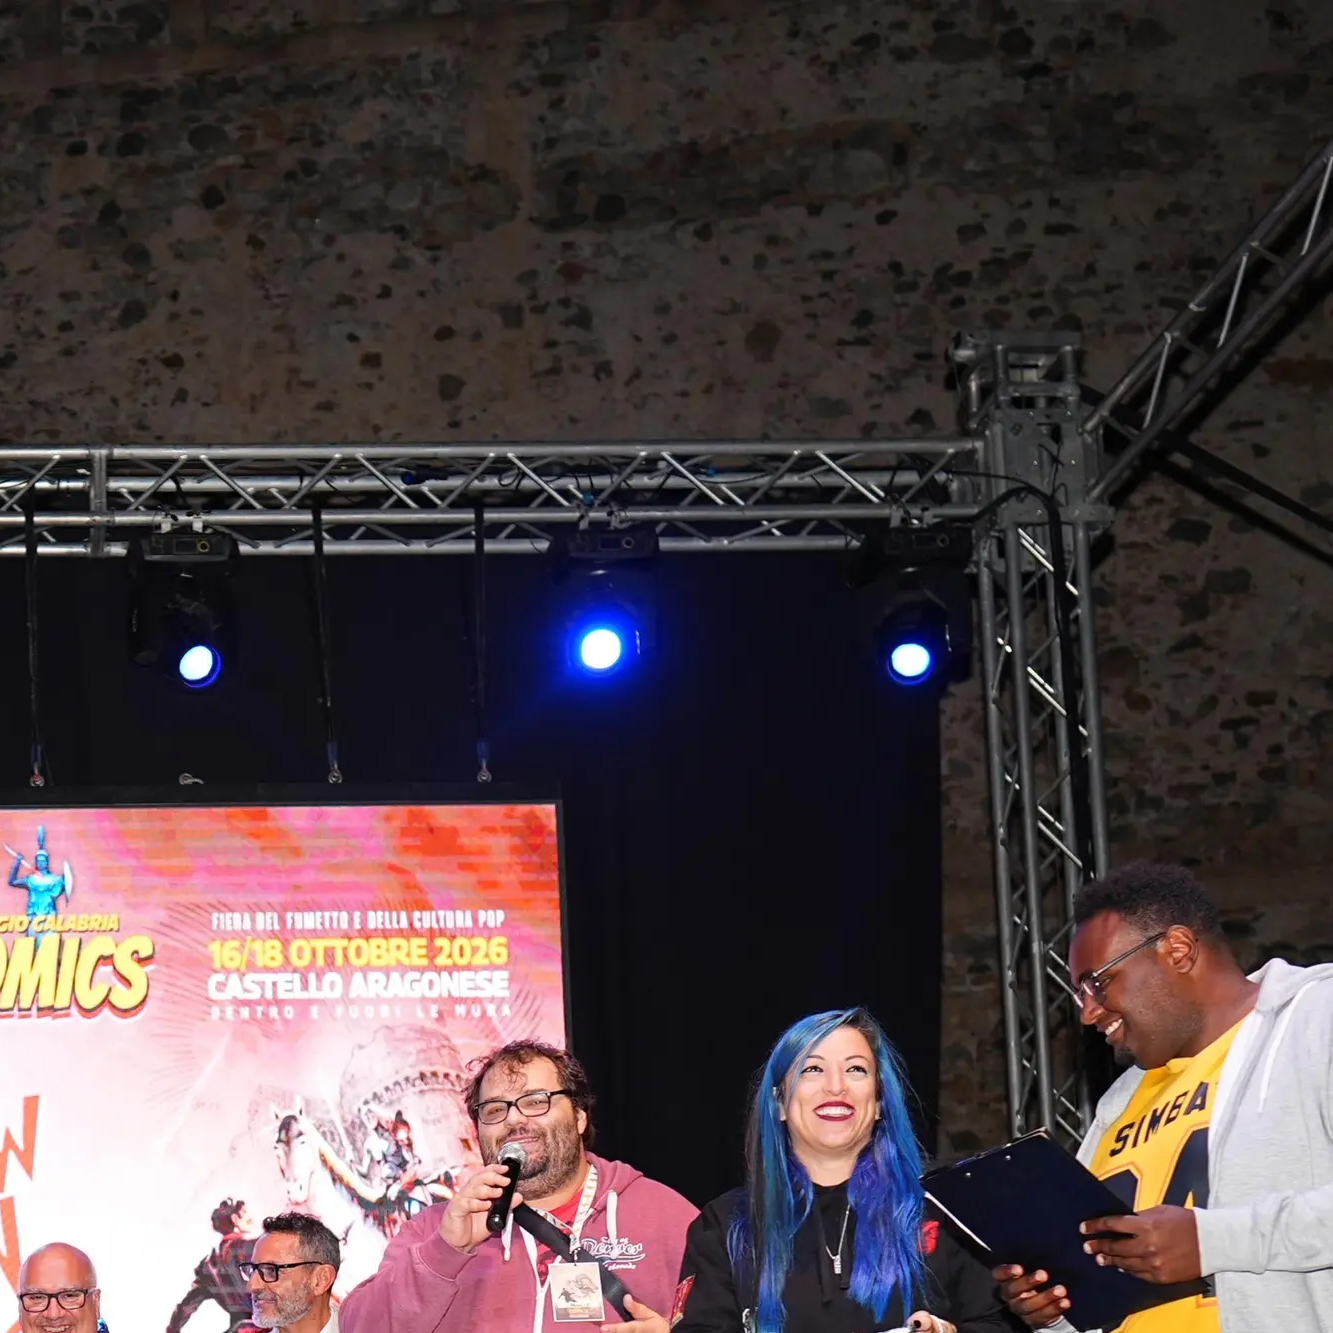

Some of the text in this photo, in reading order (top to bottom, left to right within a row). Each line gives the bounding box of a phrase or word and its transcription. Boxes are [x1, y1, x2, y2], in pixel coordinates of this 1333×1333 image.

[29, 913, 121, 933] CALABRIA
[211, 909, 506, 931] FIERA DEL FUMETTO E DELLA CULTURA POP
[207, 935, 509, 972] 16/18 OTTOBRE 2026
[207, 970, 511, 1001] CASTELLO ARAGONESE
[210, 1005, 295, 1020] DENTRO
[310, 1005, 319, 1020] E
[454, 1003, 512, 1018] MURA
[1108, 1081, 1209, 1158] SIMBA
